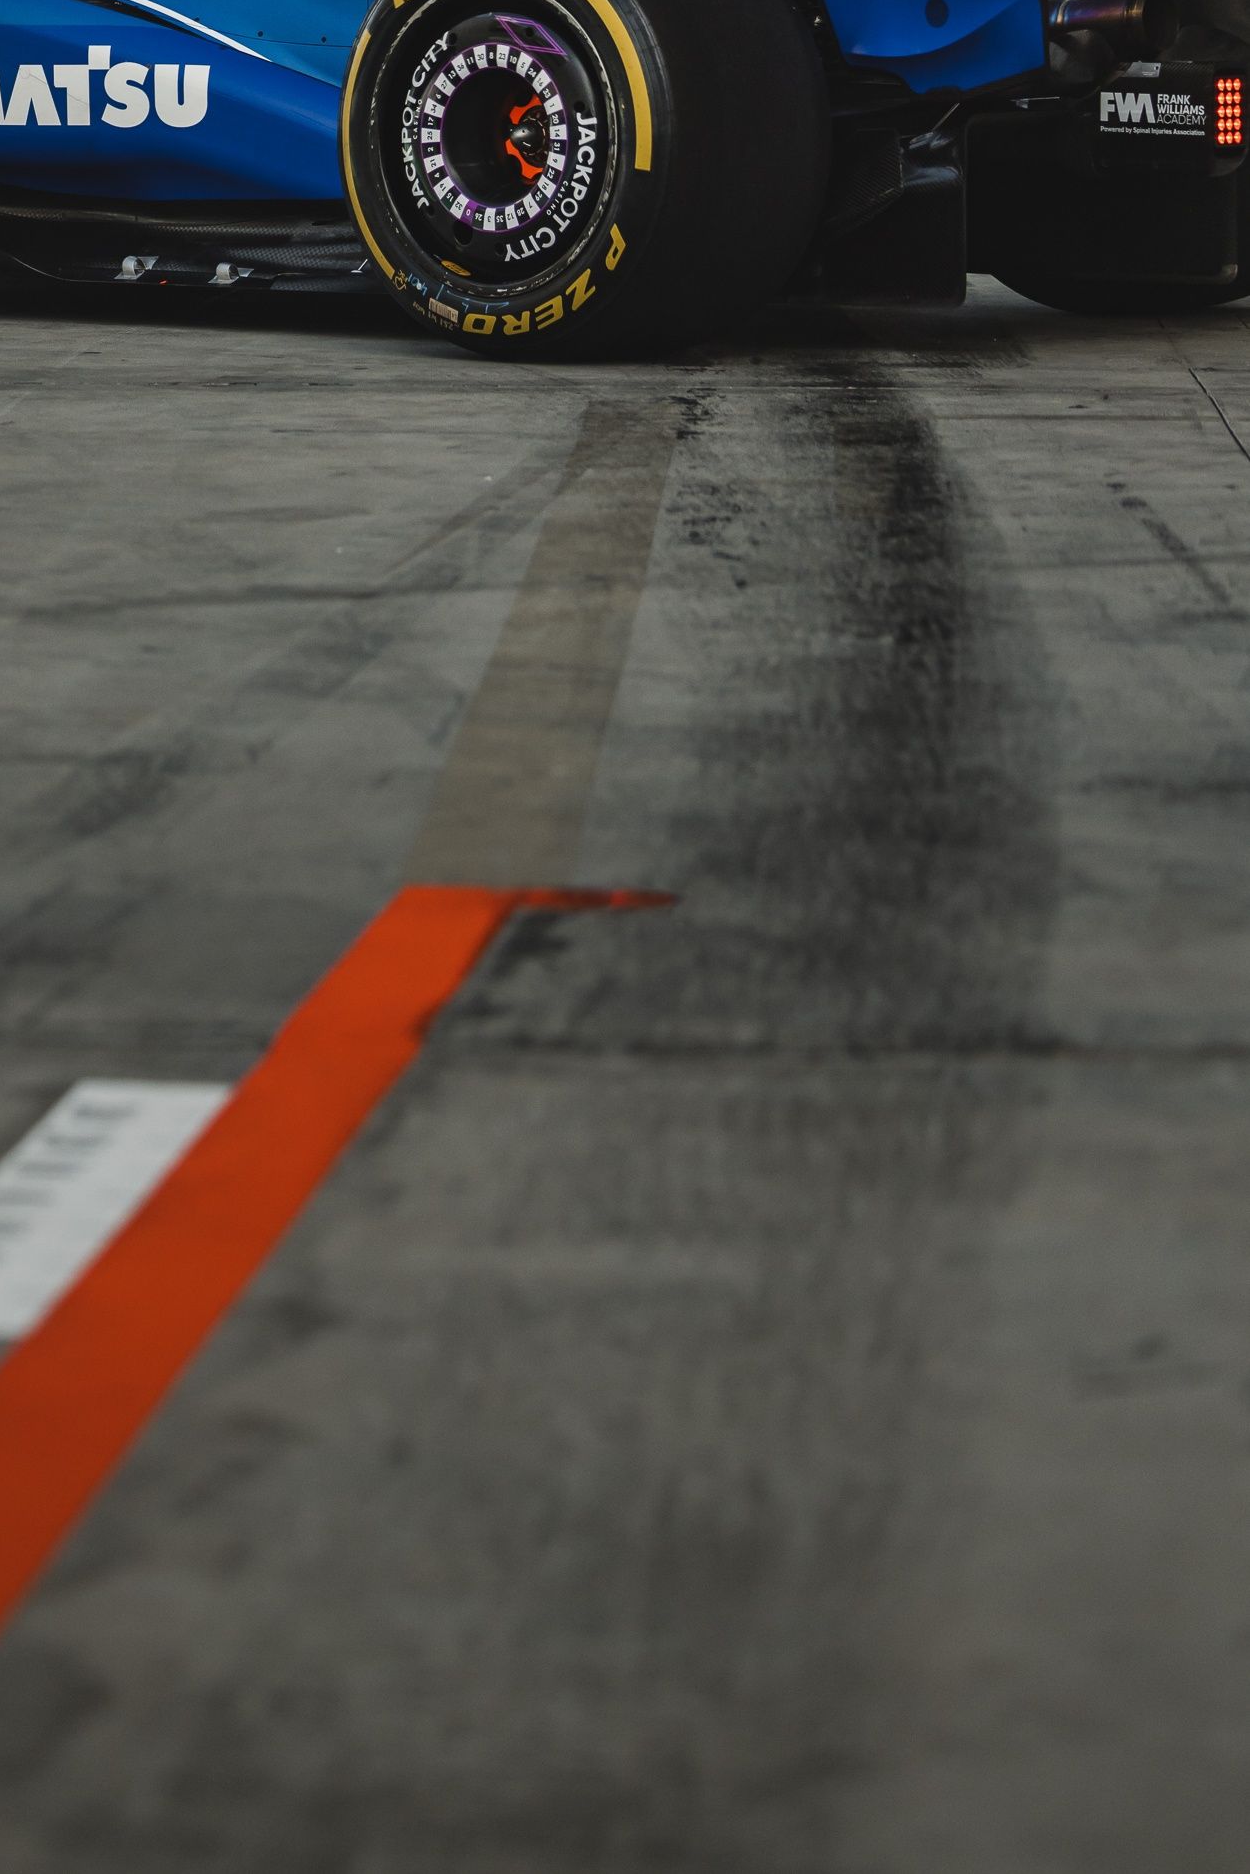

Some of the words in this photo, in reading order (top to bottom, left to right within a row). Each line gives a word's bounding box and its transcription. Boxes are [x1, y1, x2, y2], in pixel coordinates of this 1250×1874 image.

[412, 31, 450, 87] CITY
[1156, 114, 1207, 125] ACADEMY
[1157, 94, 1190, 105] FRANK
[1157, 104, 1205, 115] WILLIAMS
[402, 89, 429, 209] JACKPOT
[552, 112, 597, 233] JACKPOT
[546, 180, 568, 216] CASINO
[504, 226, 556, 261] CITY
[605, 223, 626, 270] P
[462, 268, 596, 336] ZERO
